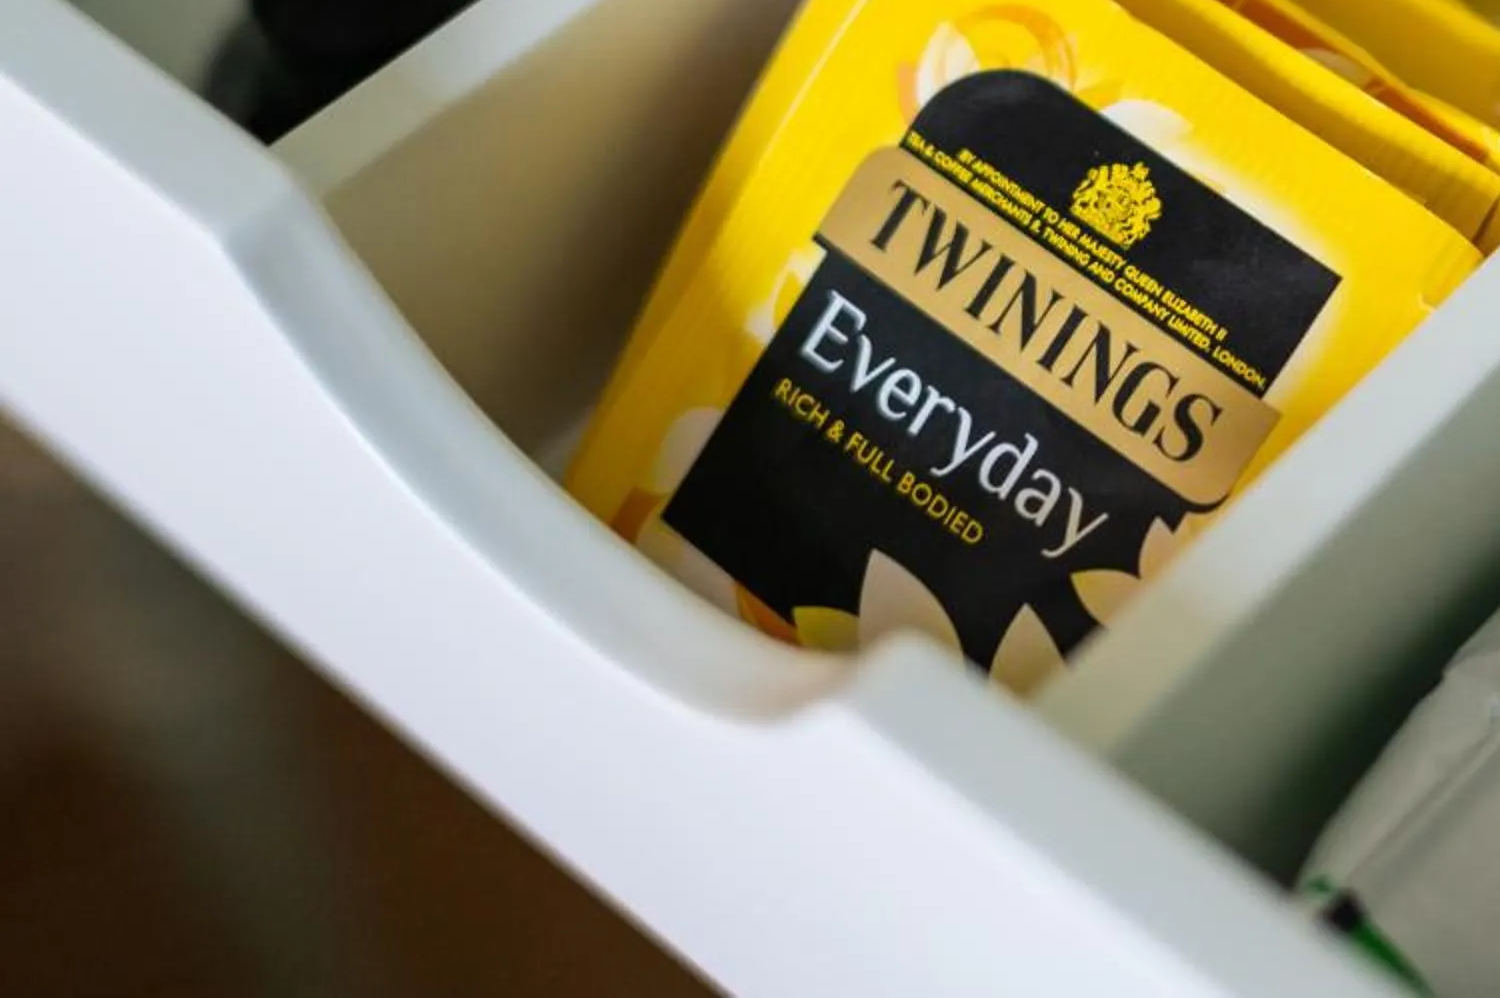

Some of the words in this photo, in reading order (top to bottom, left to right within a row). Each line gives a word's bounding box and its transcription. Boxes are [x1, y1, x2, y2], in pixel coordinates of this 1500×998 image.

[869, 178, 1224, 463] TWININGS
[907, 131, 926, 150] TEA
[933, 151, 974, 183] COFFEE
[970, 178, 1033, 226] MERCHANTS
[1043, 227, 1090, 266] TWINING
[1088, 262, 1115, 283] AND
[1114, 277, 1170, 321] COMPANY
[957, 148, 976, 164] BY
[972, 158, 1046, 213] APPOINTMENT
[1043, 207, 1059, 223] TO
[1058, 218, 1081, 240] HER
[1079, 234, 1127, 269] MAJESTY
[1124, 265, 1165, 297] QUEEN
[1161, 290, 1219, 335] ELIZABETH
[1215, 326, 1229, 342] II
[773, 378, 828, 428] RICH
[826, 421, 847, 444] &
[844, 433, 896, 482] FULL
[898, 471, 986, 545] BODIED
[799, 289, 1109, 558] Everyday
